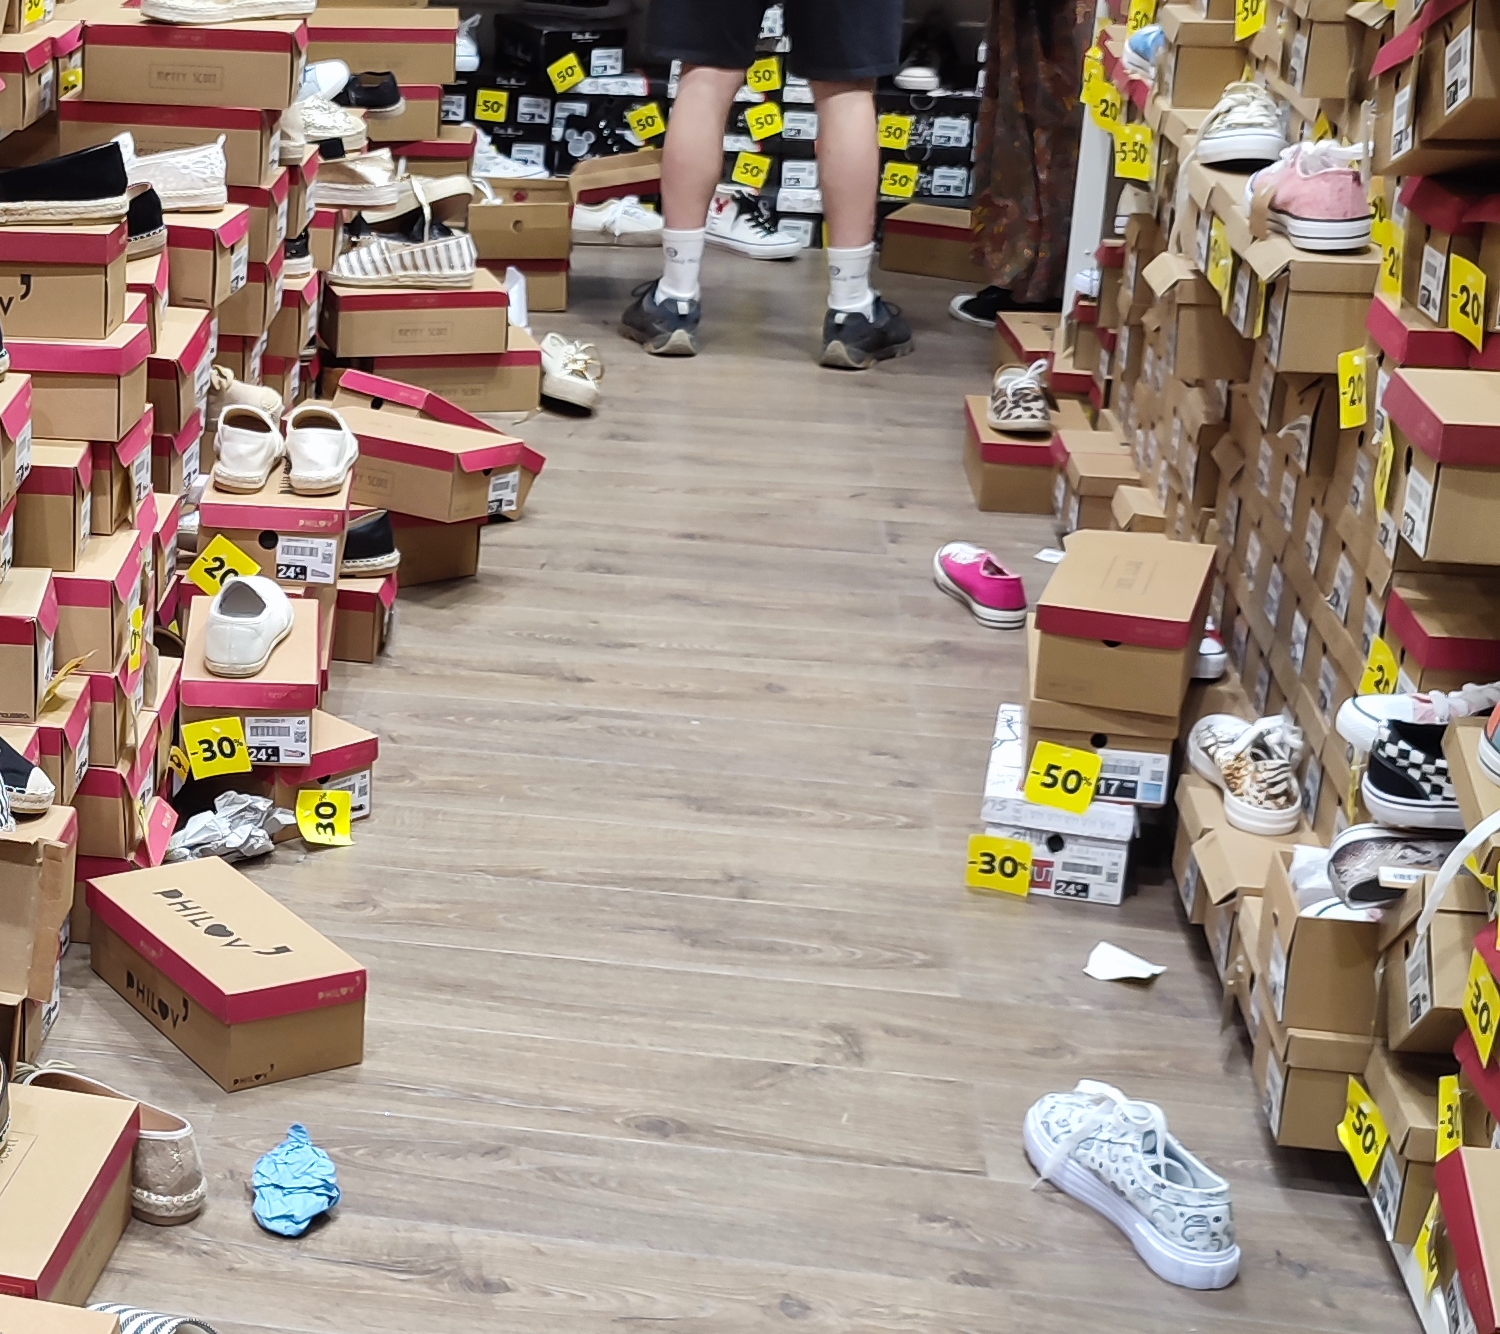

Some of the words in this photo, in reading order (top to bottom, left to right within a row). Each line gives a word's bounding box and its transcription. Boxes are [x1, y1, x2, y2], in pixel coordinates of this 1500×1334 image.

[191, 737, 243, 762] -30%
[1031, 763, 1092, 794] -50%
[316, 793, 338, 842] -30%
[968, 852, 1027, 878] -30%
